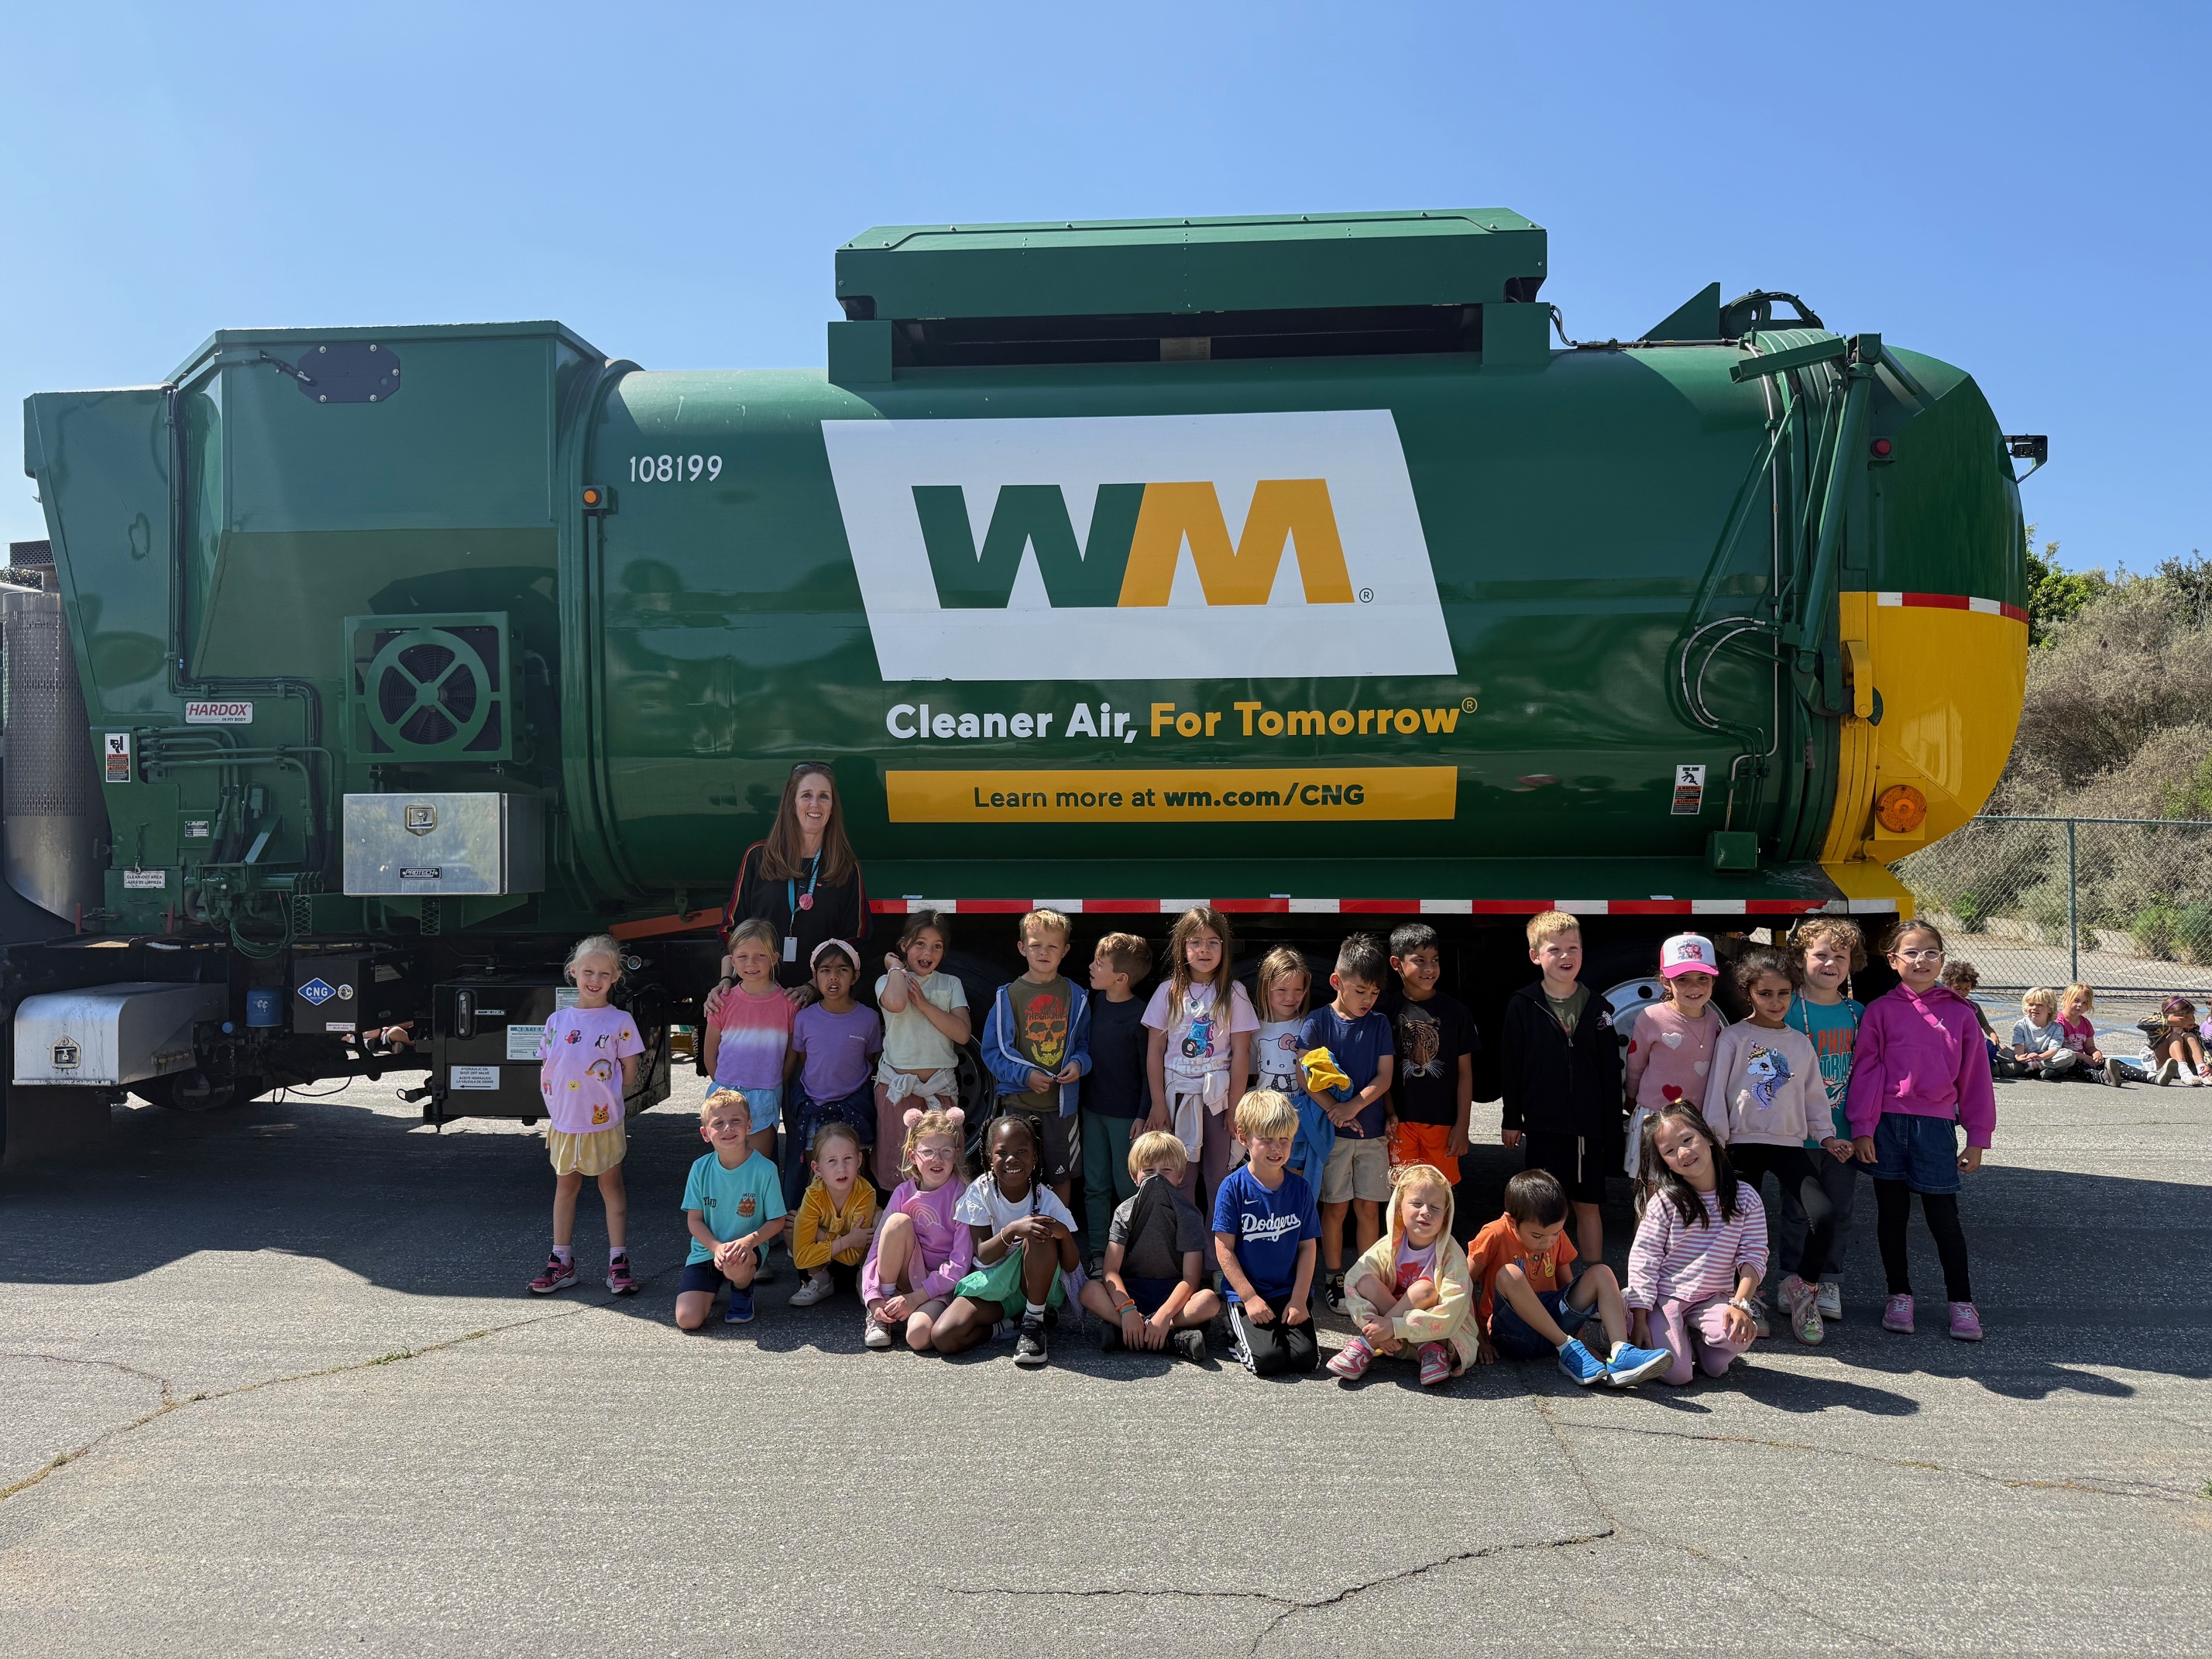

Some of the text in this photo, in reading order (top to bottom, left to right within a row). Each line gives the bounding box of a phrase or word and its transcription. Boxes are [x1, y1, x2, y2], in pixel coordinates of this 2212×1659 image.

[630, 454, 723, 483] 108199
[886, 703, 1053, 739] Cleaner
[1064, 702, 1138, 744] Air,
[1151, 702, 1221, 737] For
[974, 781, 1365, 808] Learn more at wm.com/CNG
[306, 987, 328, 997] CNG
[1241, 1212, 1301, 1242] Dodgers
